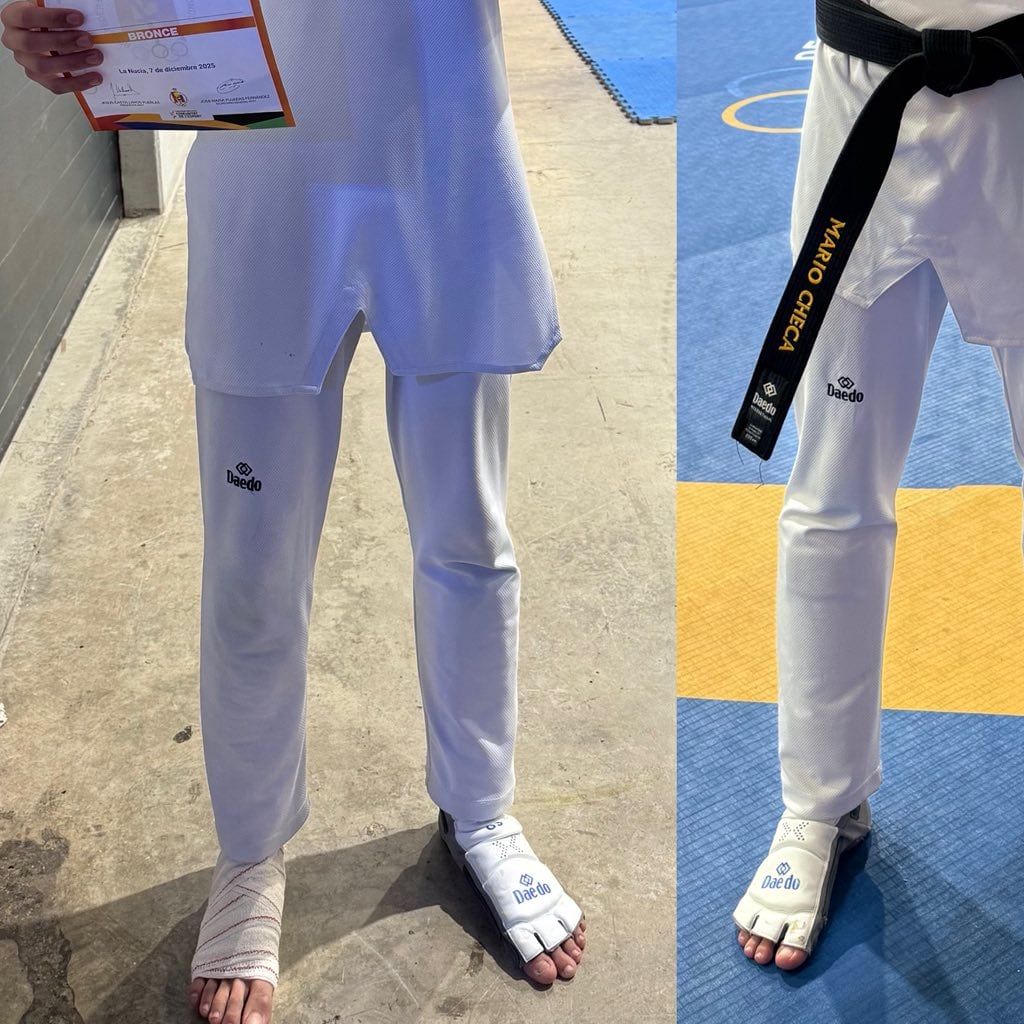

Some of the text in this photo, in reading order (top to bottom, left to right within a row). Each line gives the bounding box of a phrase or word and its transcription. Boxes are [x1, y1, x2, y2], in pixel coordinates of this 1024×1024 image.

[128, 26, 180, 42] BRONCE
[164, 64, 198, 74] diciembre
[198, 62, 217, 71] 2025
[778, 216, 847, 353] MARIO CHECA
[827, 383, 864, 403] Daedo
[752, 392, 777, 416] Daedo
[226, 469, 262, 492] Daedo
[761, 873, 801, 891] Daedo
[512, 881, 551, 905] Daedo
